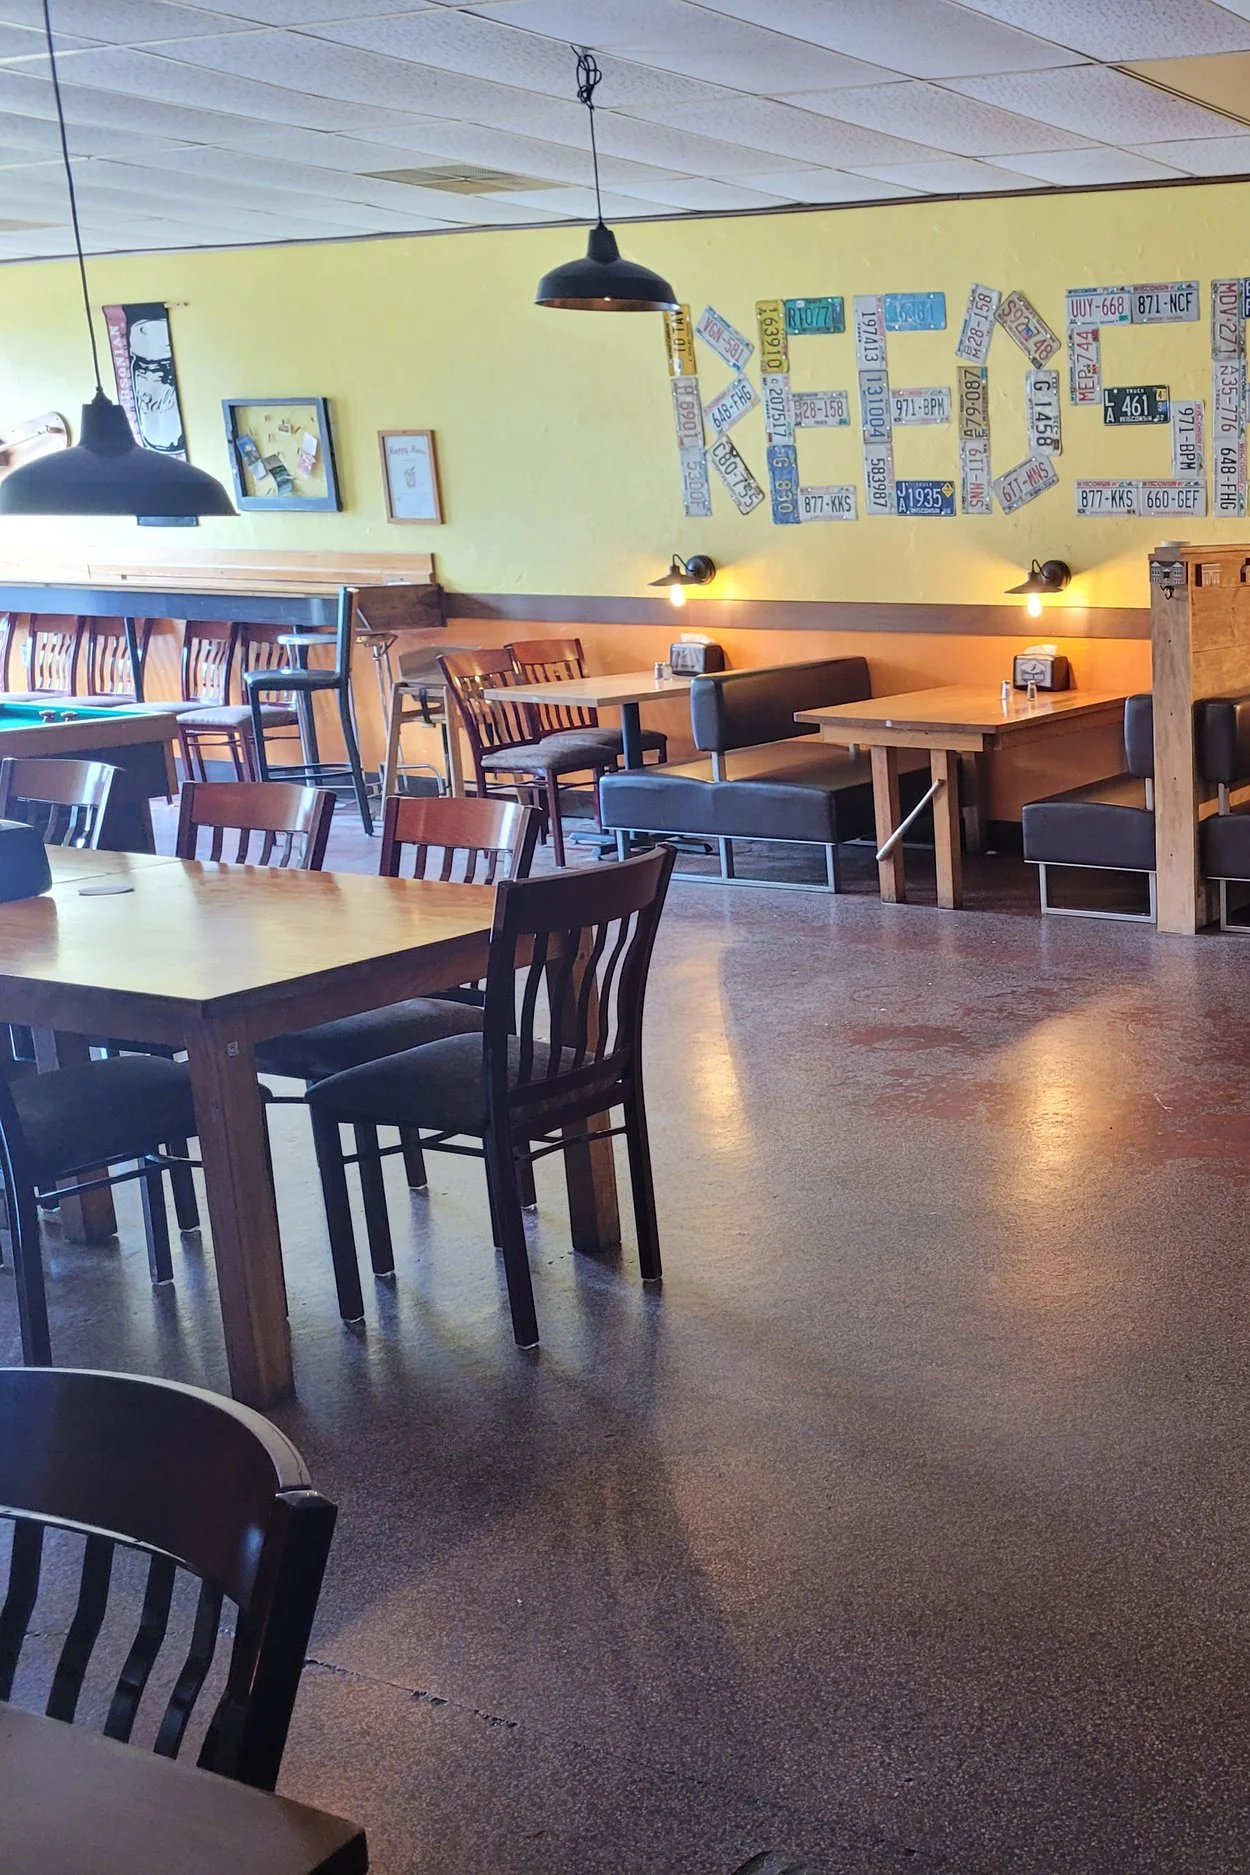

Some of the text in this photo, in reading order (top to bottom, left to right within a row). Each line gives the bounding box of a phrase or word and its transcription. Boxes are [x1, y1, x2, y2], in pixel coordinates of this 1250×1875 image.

[1071, 296, 1124, 318] UUY-668
[1138, 292, 1193, 314] 871-NCF
[861, 311, 880, 363] 197413
[712, 385, 752, 428] 648-FHG
[769, 387, 788, 438] 207517
[802, 399, 844, 419] 28-158
[866, 377, 886, 438] 131004
[895, 397, 945, 418] 971-BPM
[1121, 395, 1149, 416] 461
[1220, 376, 1238, 432] 35-776
[1034, 402, 1054, 447] 1458
[1119, 415, 1153, 423] WISCONSIN
[1178, 407, 1196, 470] 971-BPM
[870, 458, 888, 508] 583987
[1220, 446, 1237, 510] 648-FHG
[804, 494, 851, 514] 877-KKS
[908, 488, 942, 508] 1935
[1081, 489, 1133, 509] 877-KKS
[1147, 489, 1200, 509] 660-GEF
